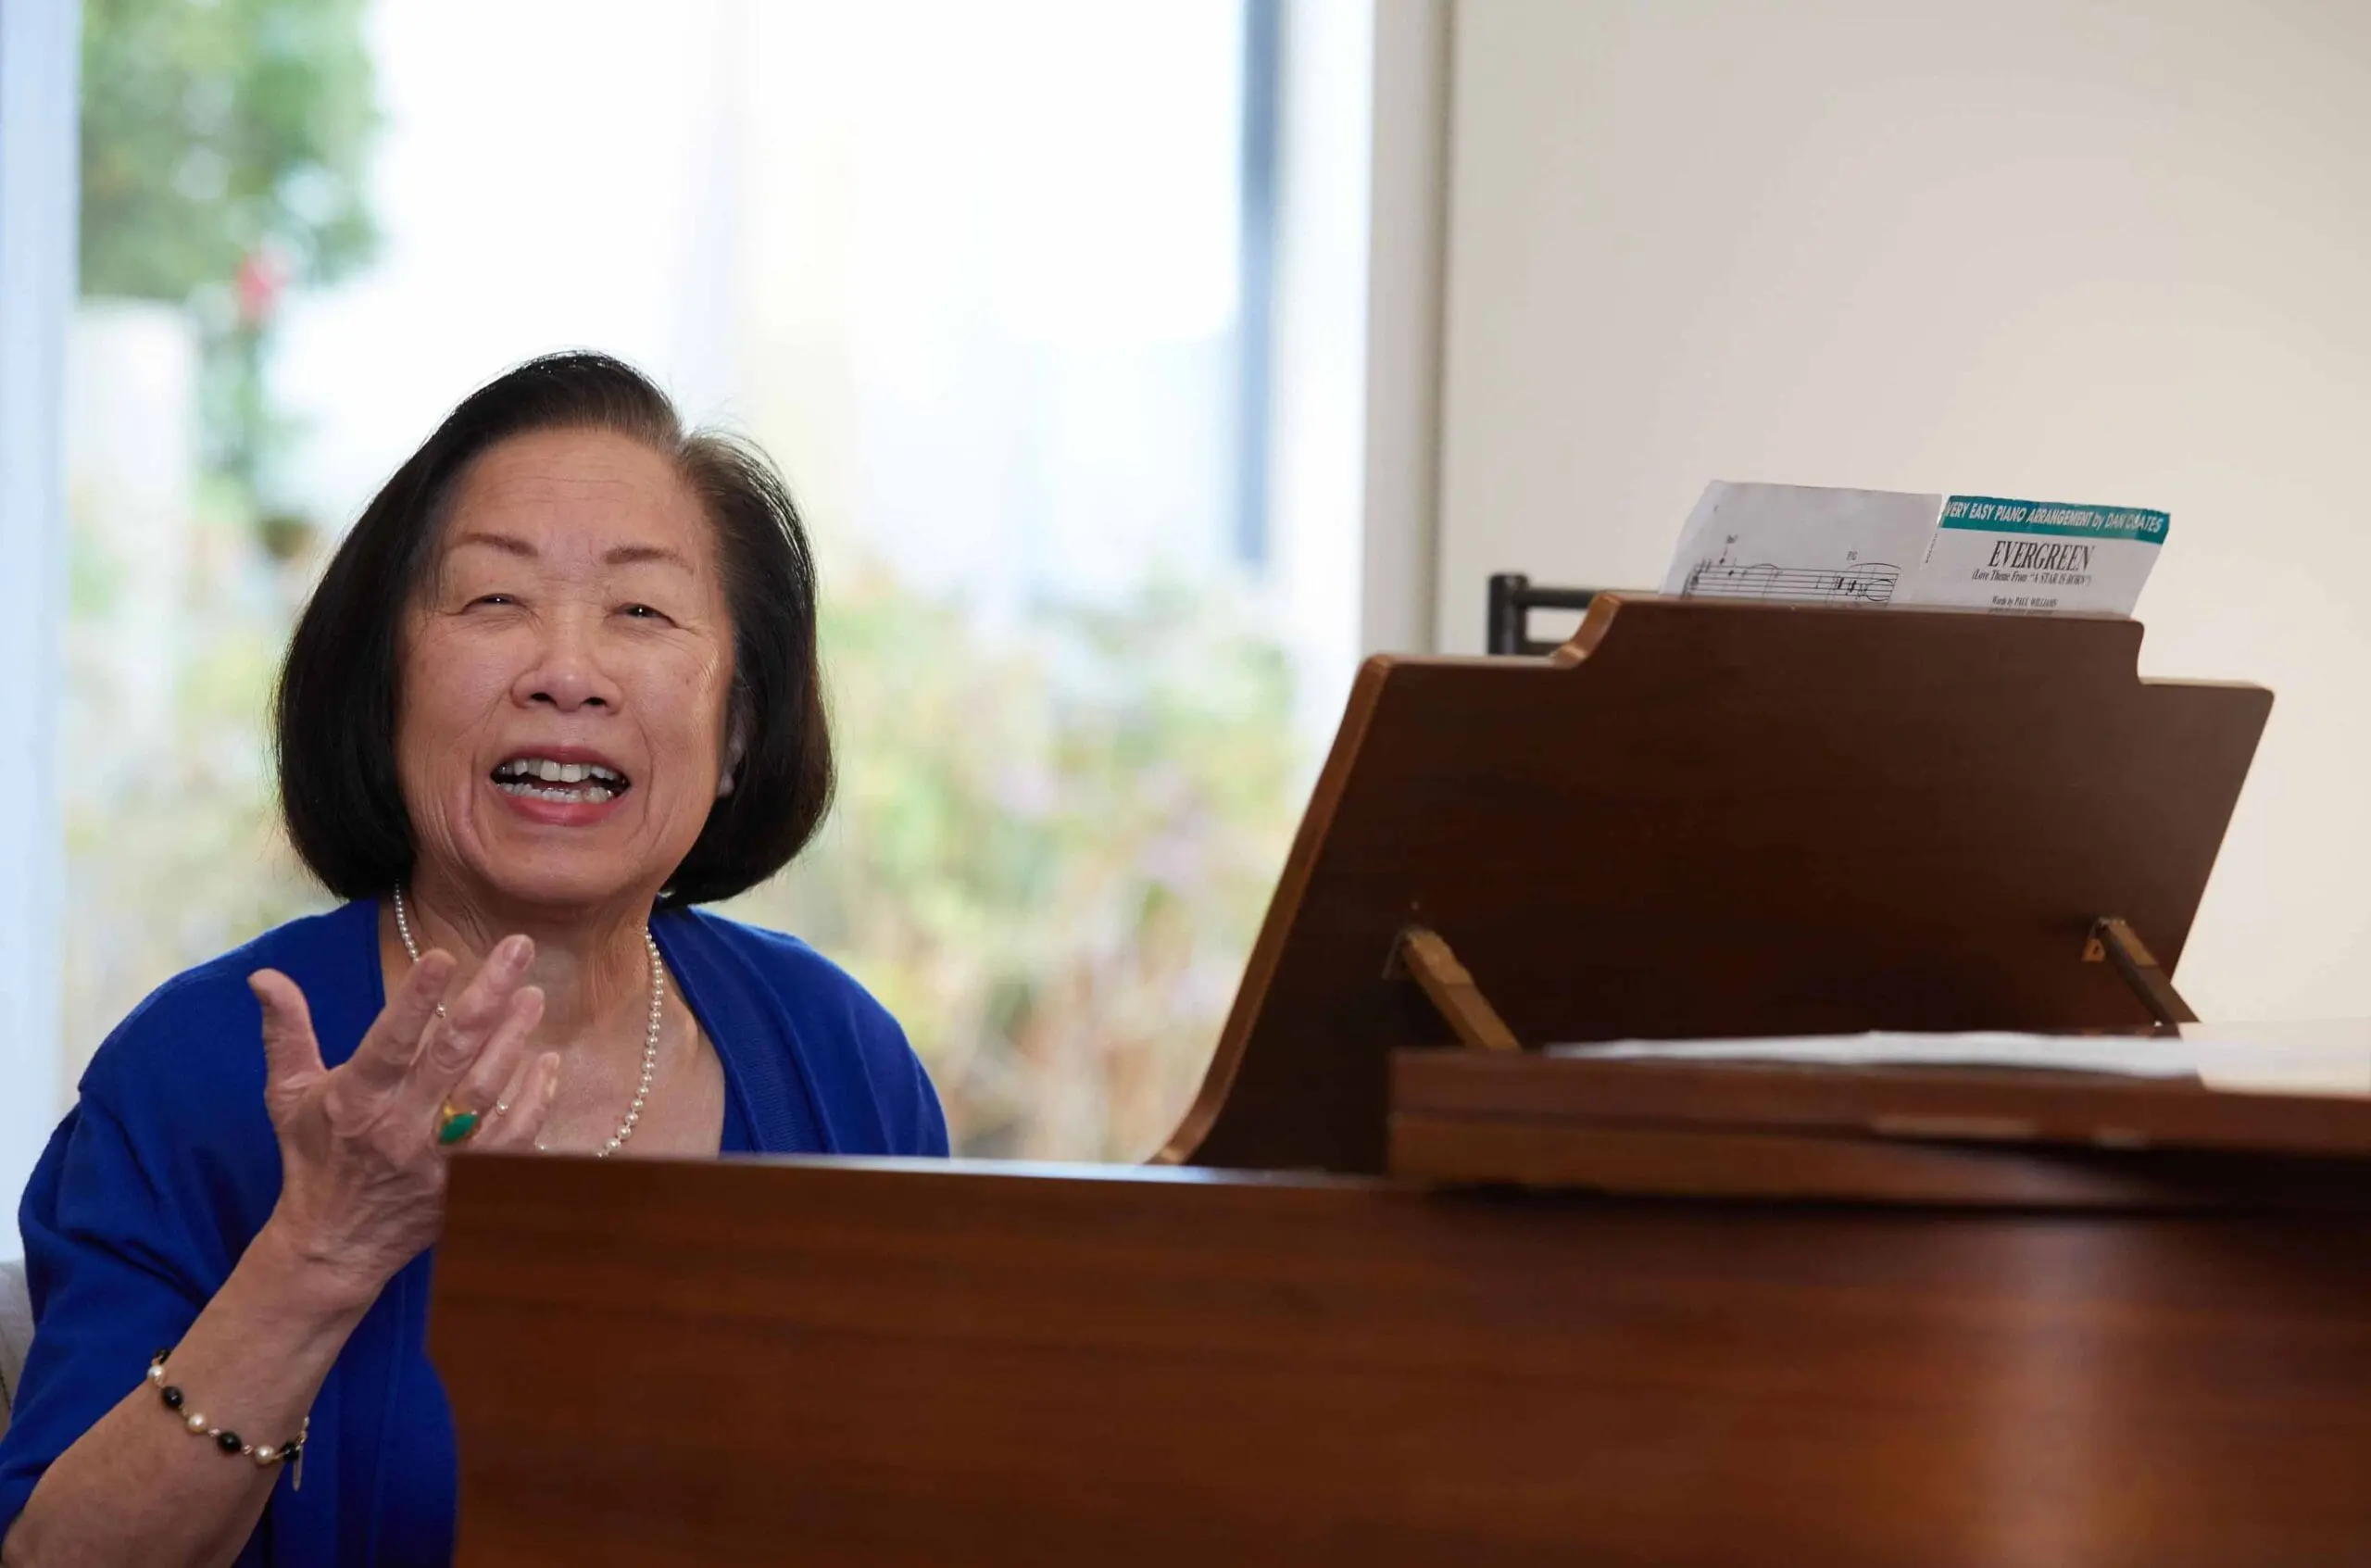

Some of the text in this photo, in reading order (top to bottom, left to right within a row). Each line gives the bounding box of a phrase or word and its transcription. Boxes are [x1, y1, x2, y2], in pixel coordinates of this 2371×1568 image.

[1944, 501, 1970, 518] VERY
[1969, 503, 1996, 521] EASY
[1994, 506, 2026, 522] PIANO
[2026, 508, 2093, 527] ARRANGEMENT
[2091, 515, 2106, 532] by
[2104, 513, 2126, 530] DAN
[1988, 540, 2096, 571] EVERGREEN
